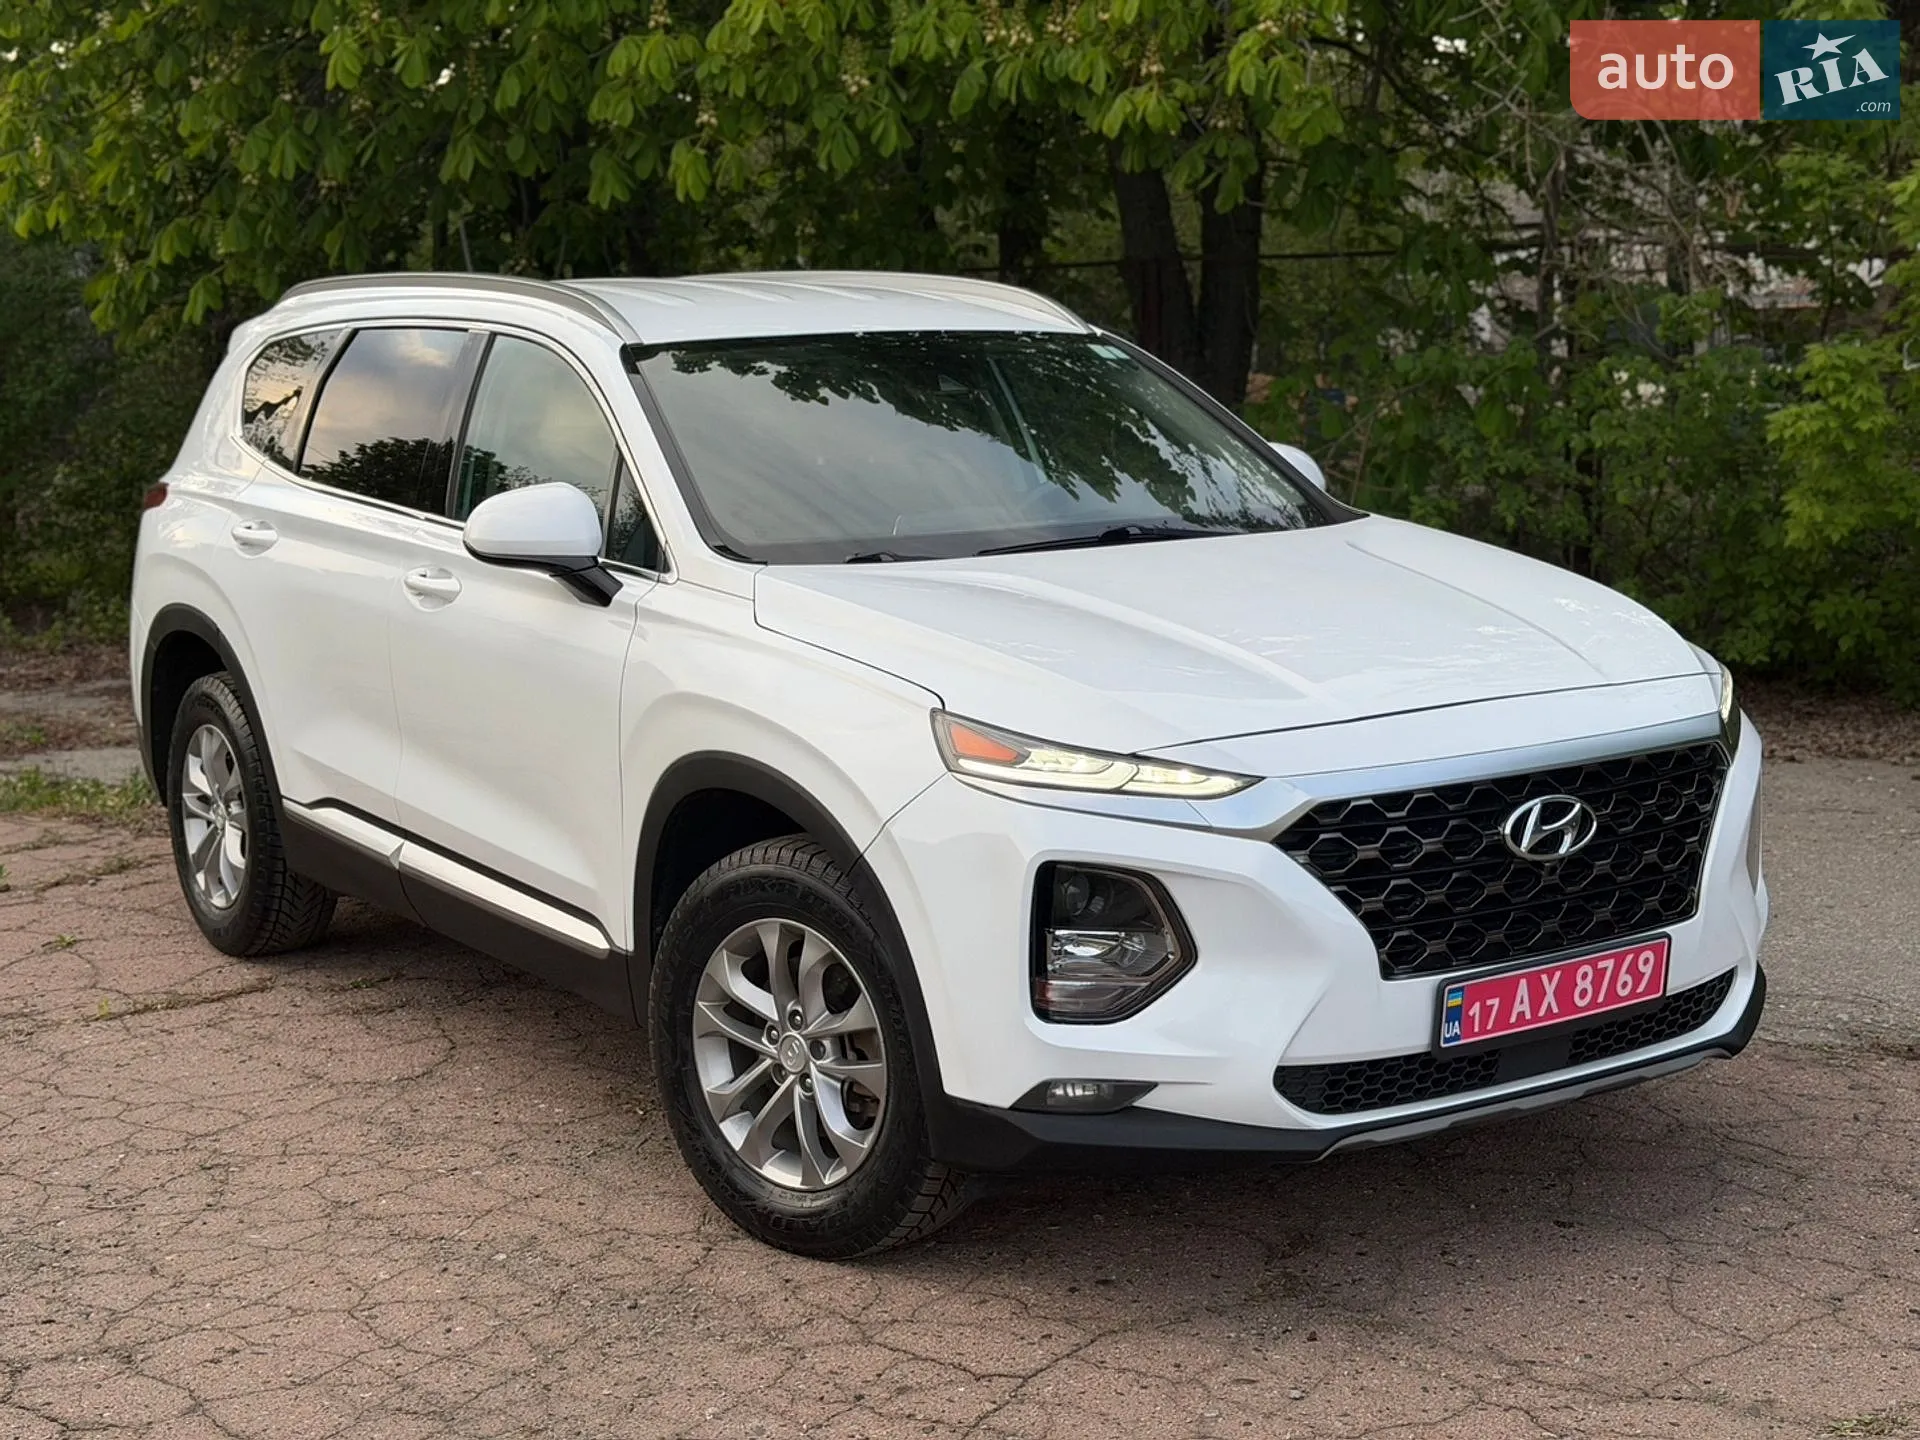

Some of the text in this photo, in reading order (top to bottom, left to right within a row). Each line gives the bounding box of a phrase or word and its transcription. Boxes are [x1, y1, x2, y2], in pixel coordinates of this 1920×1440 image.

[1468, 950, 1655, 1033] 17 AX 8769
[1445, 1021, 1461, 1038] UA
